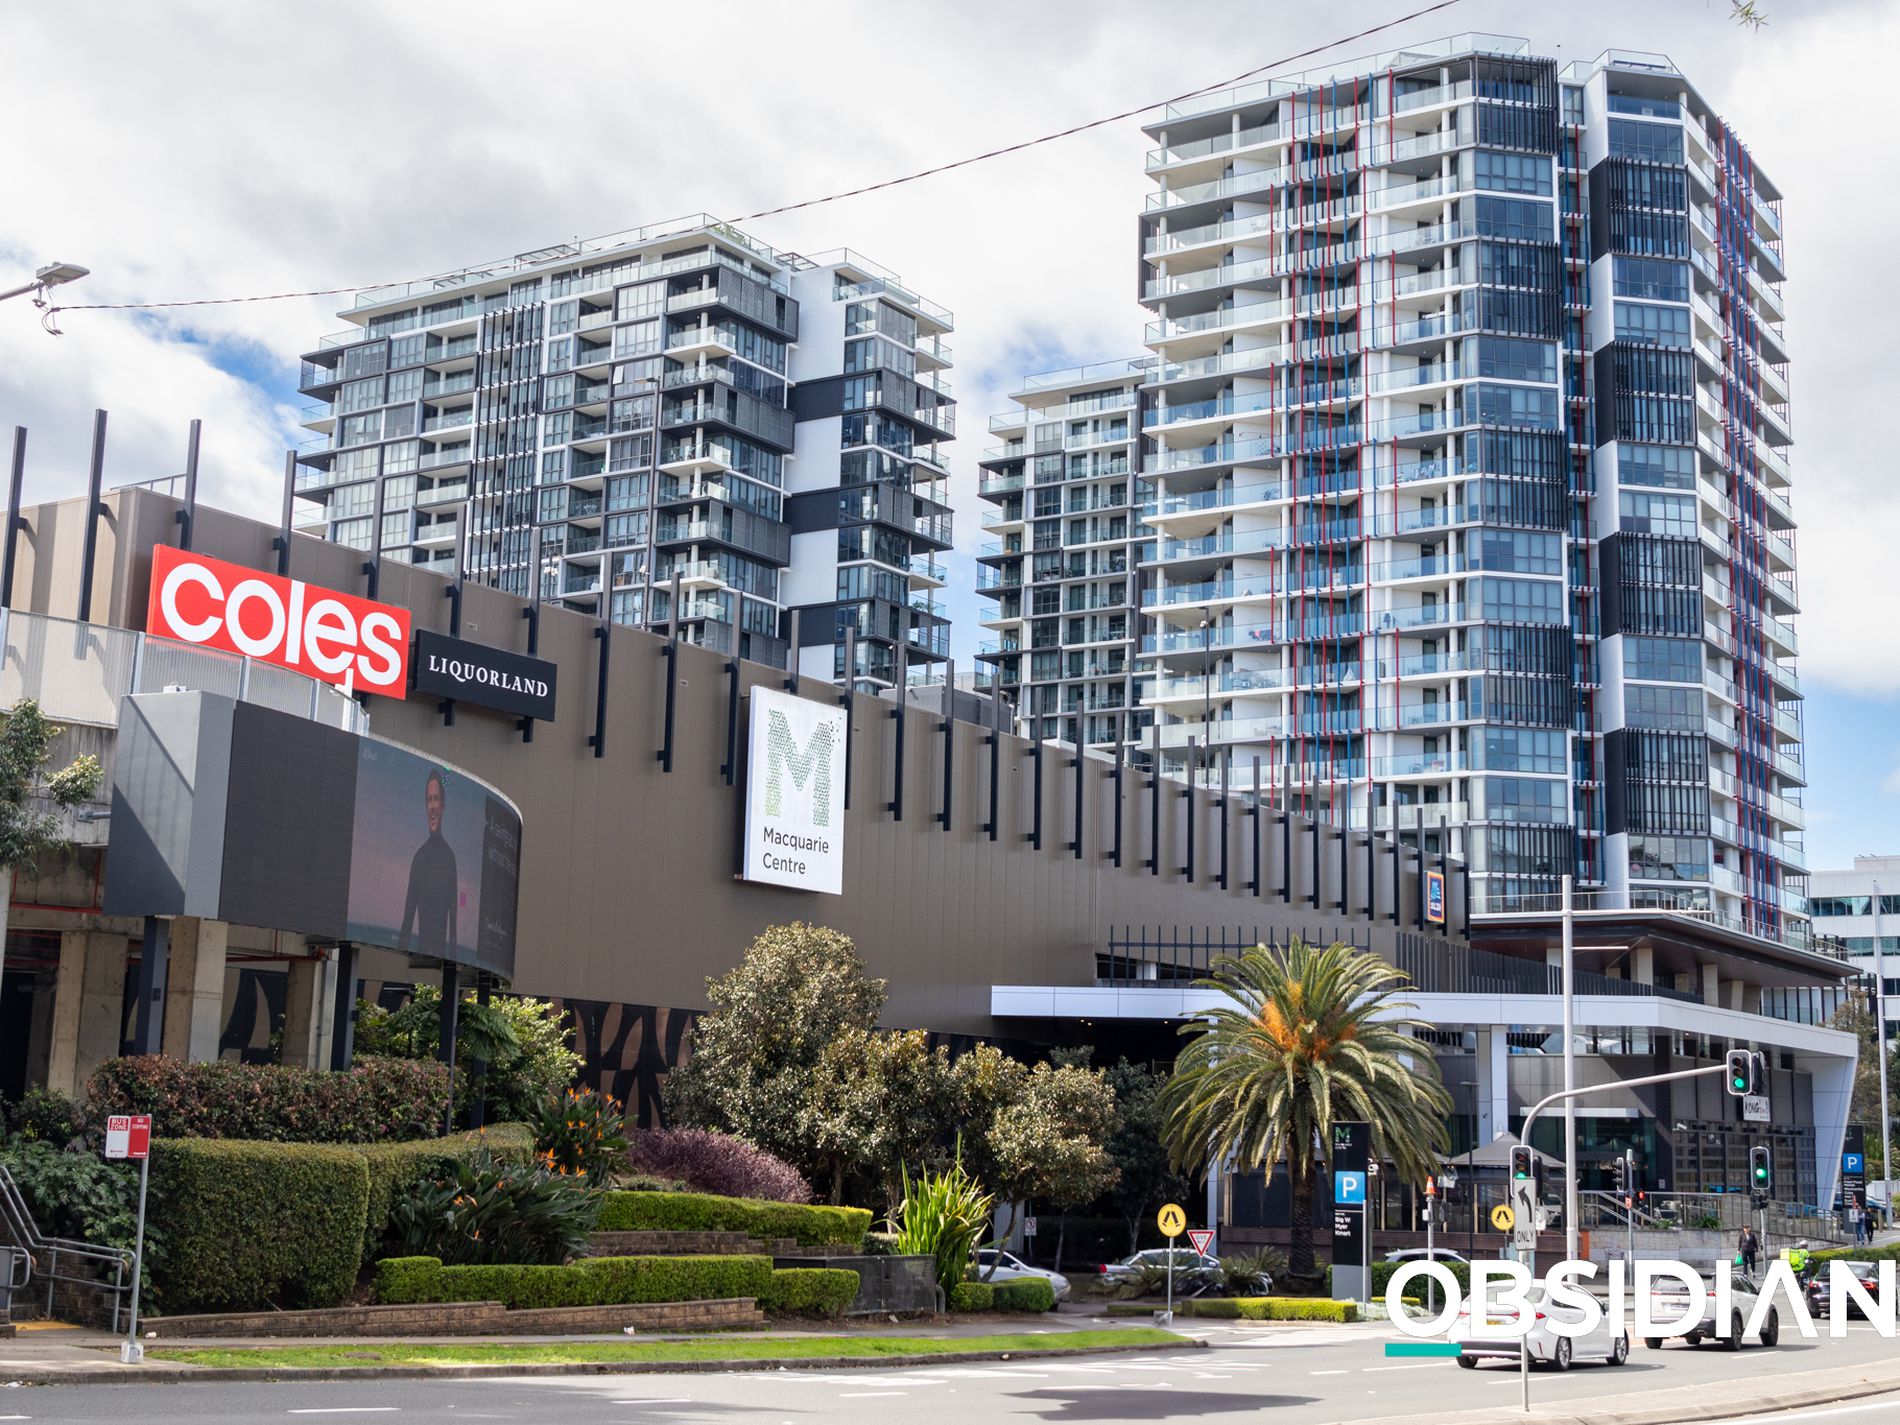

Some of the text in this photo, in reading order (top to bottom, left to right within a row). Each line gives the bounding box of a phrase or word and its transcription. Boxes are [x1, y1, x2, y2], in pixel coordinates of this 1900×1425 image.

[161, 563, 402, 686] coles
[429, 655, 549, 698] LIQUORLAND
[765, 708, 838, 827] M
[763, 826, 829, 853] Macquarie
[763, 852, 806, 875] Centre
[1847, 1156, 1858, 1169] P
[1343, 1176, 1357, 1199] P
[1335, 1216, 1344, 1224] Big
[1517, 1230, 1534, 1243] ONLY
